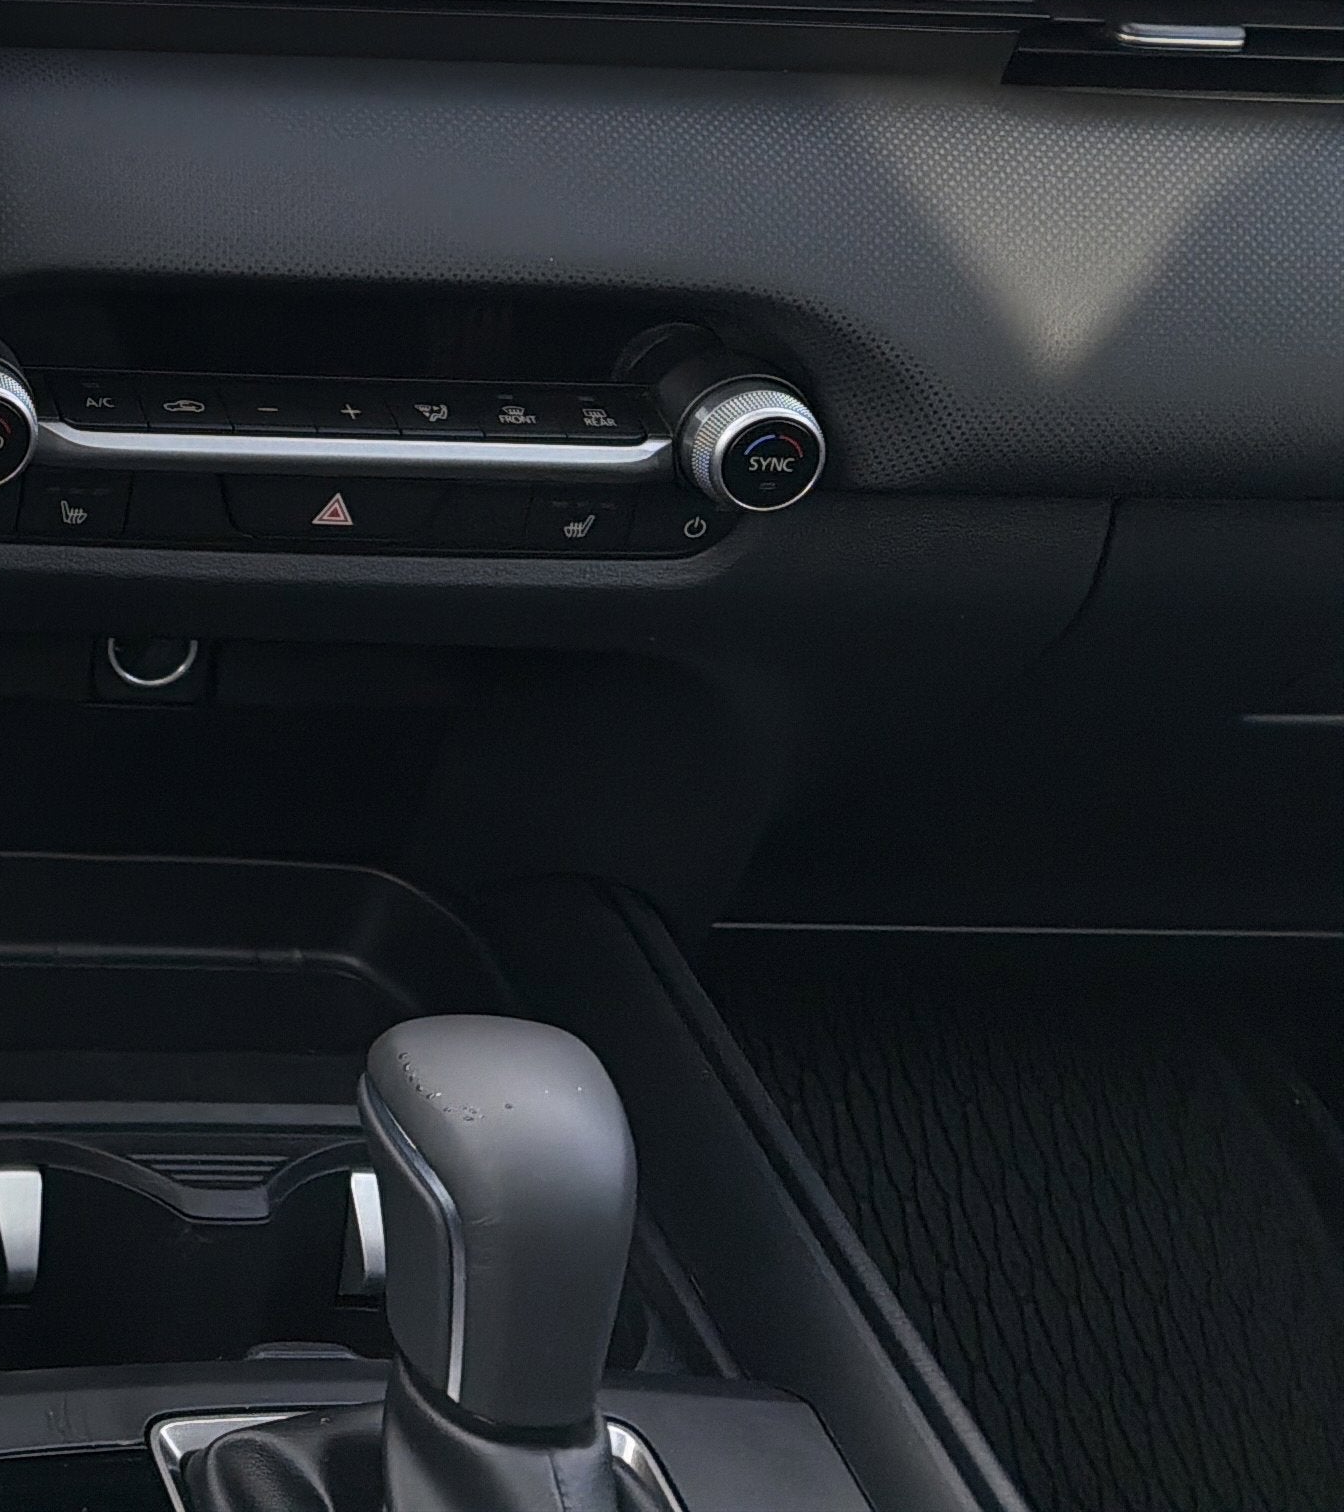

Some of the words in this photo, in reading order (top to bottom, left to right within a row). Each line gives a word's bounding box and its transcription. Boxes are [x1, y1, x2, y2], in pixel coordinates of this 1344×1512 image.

[85, 396, 115, 409] A/C
[497, 413, 537, 426] FRONT
[583, 416, 617, 428] REAR
[748, 454, 795, 473] SYNC
